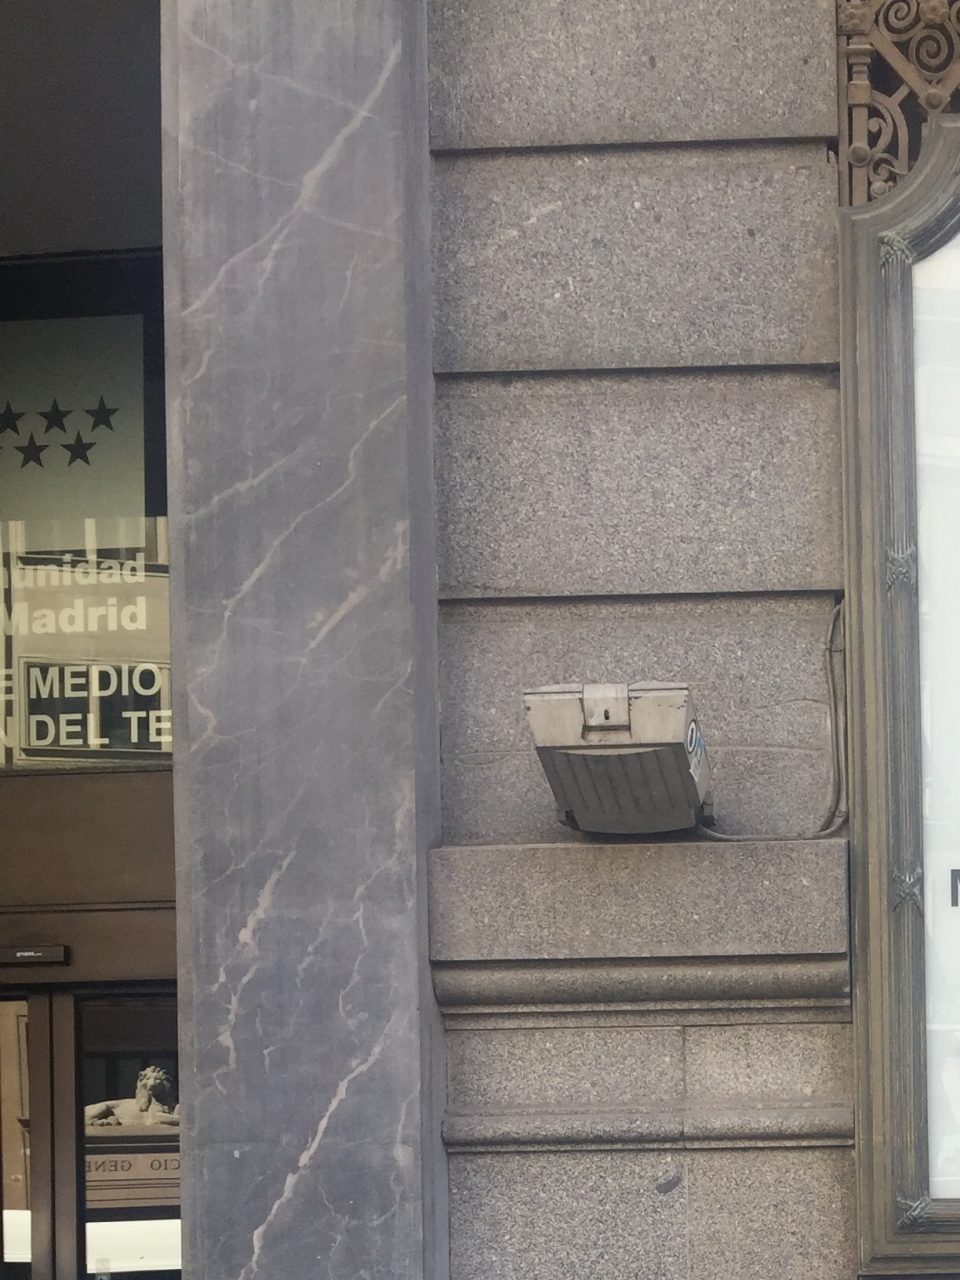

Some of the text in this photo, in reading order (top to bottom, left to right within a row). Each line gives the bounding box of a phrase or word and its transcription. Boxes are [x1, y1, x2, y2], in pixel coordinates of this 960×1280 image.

[29, 663, 163, 699] MEDIO
[29, 712, 110, 746] DEL
[122, 709, 173, 744] TE
